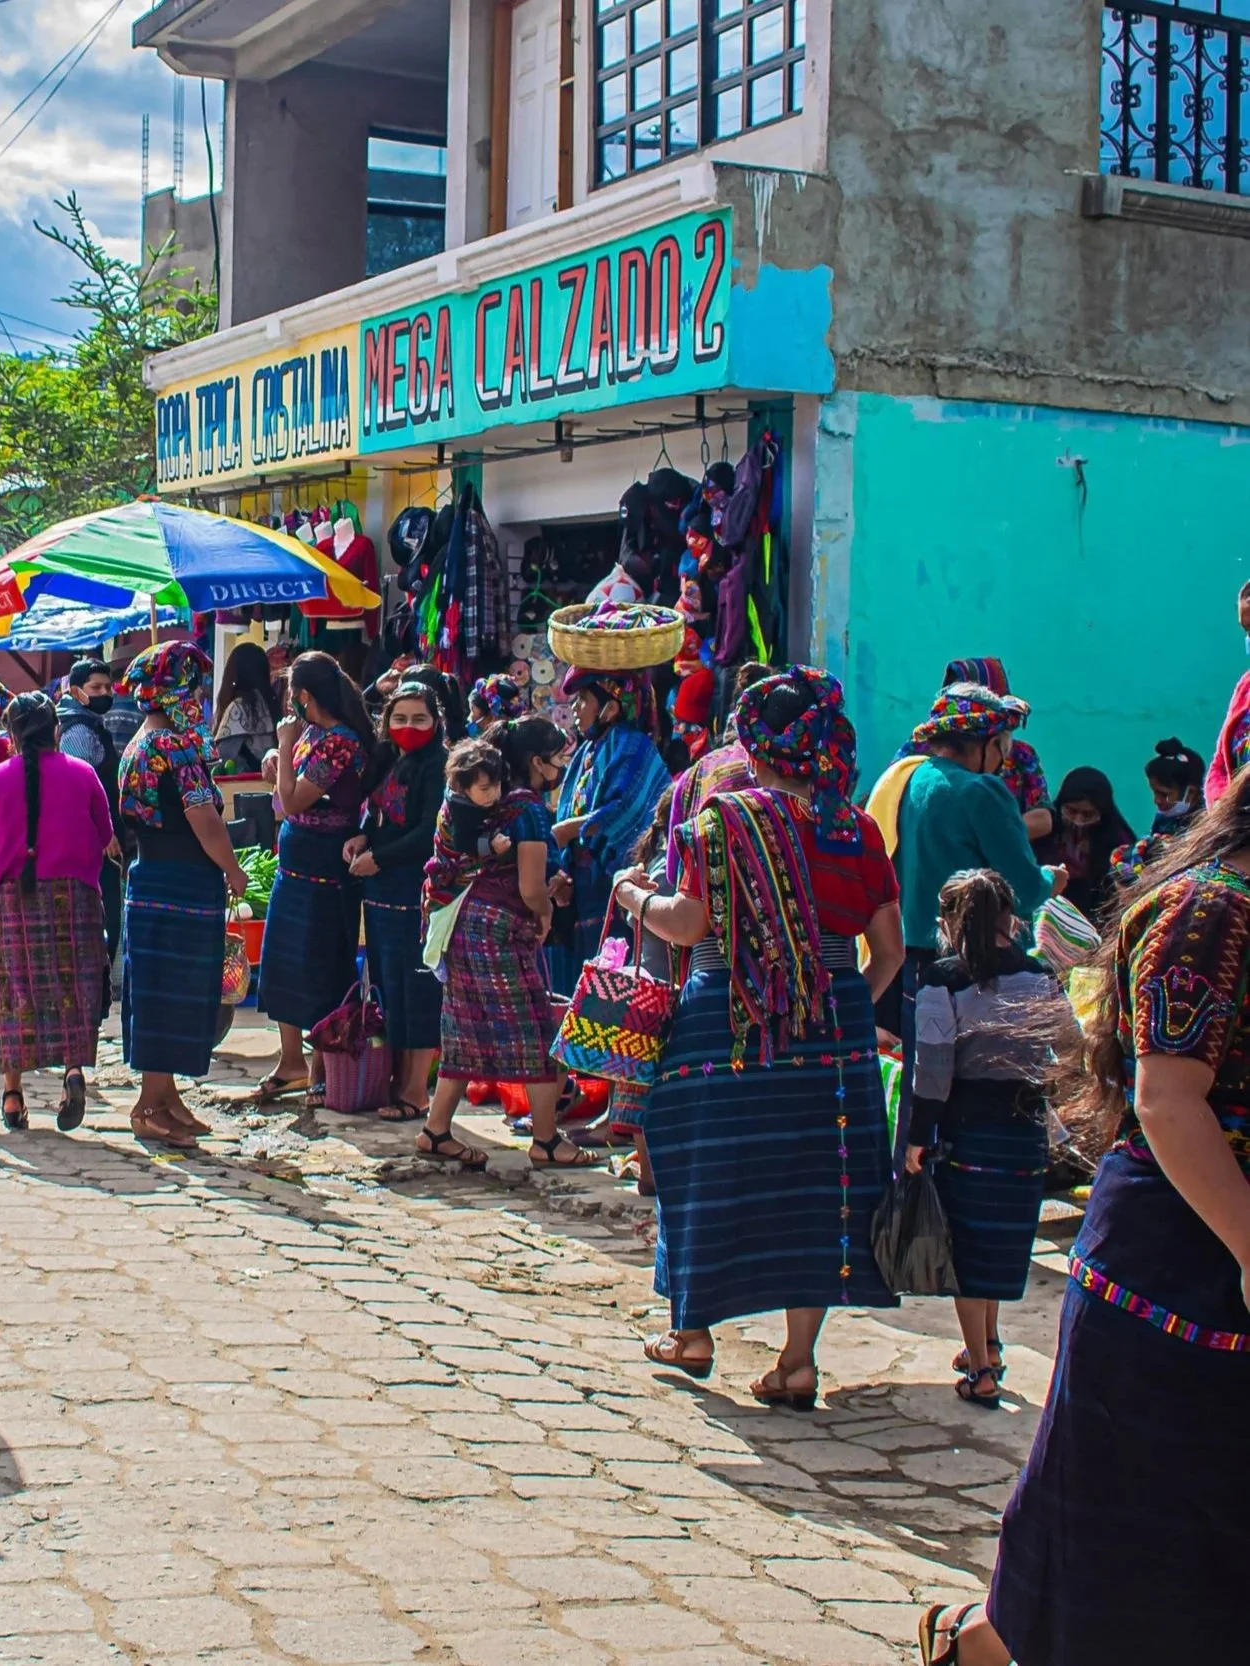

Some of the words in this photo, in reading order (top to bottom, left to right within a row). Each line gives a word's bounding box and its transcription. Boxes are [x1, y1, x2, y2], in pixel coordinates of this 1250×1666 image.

[363, 305, 454, 436] MEGA
[475, 234, 681, 412] CALZADO
[157, 391, 192, 484] ROPA
[196, 375, 242, 477] TIPICA
[251, 346, 350, 466] CRISTALINA
[210, 580, 313, 601] DIRECT
